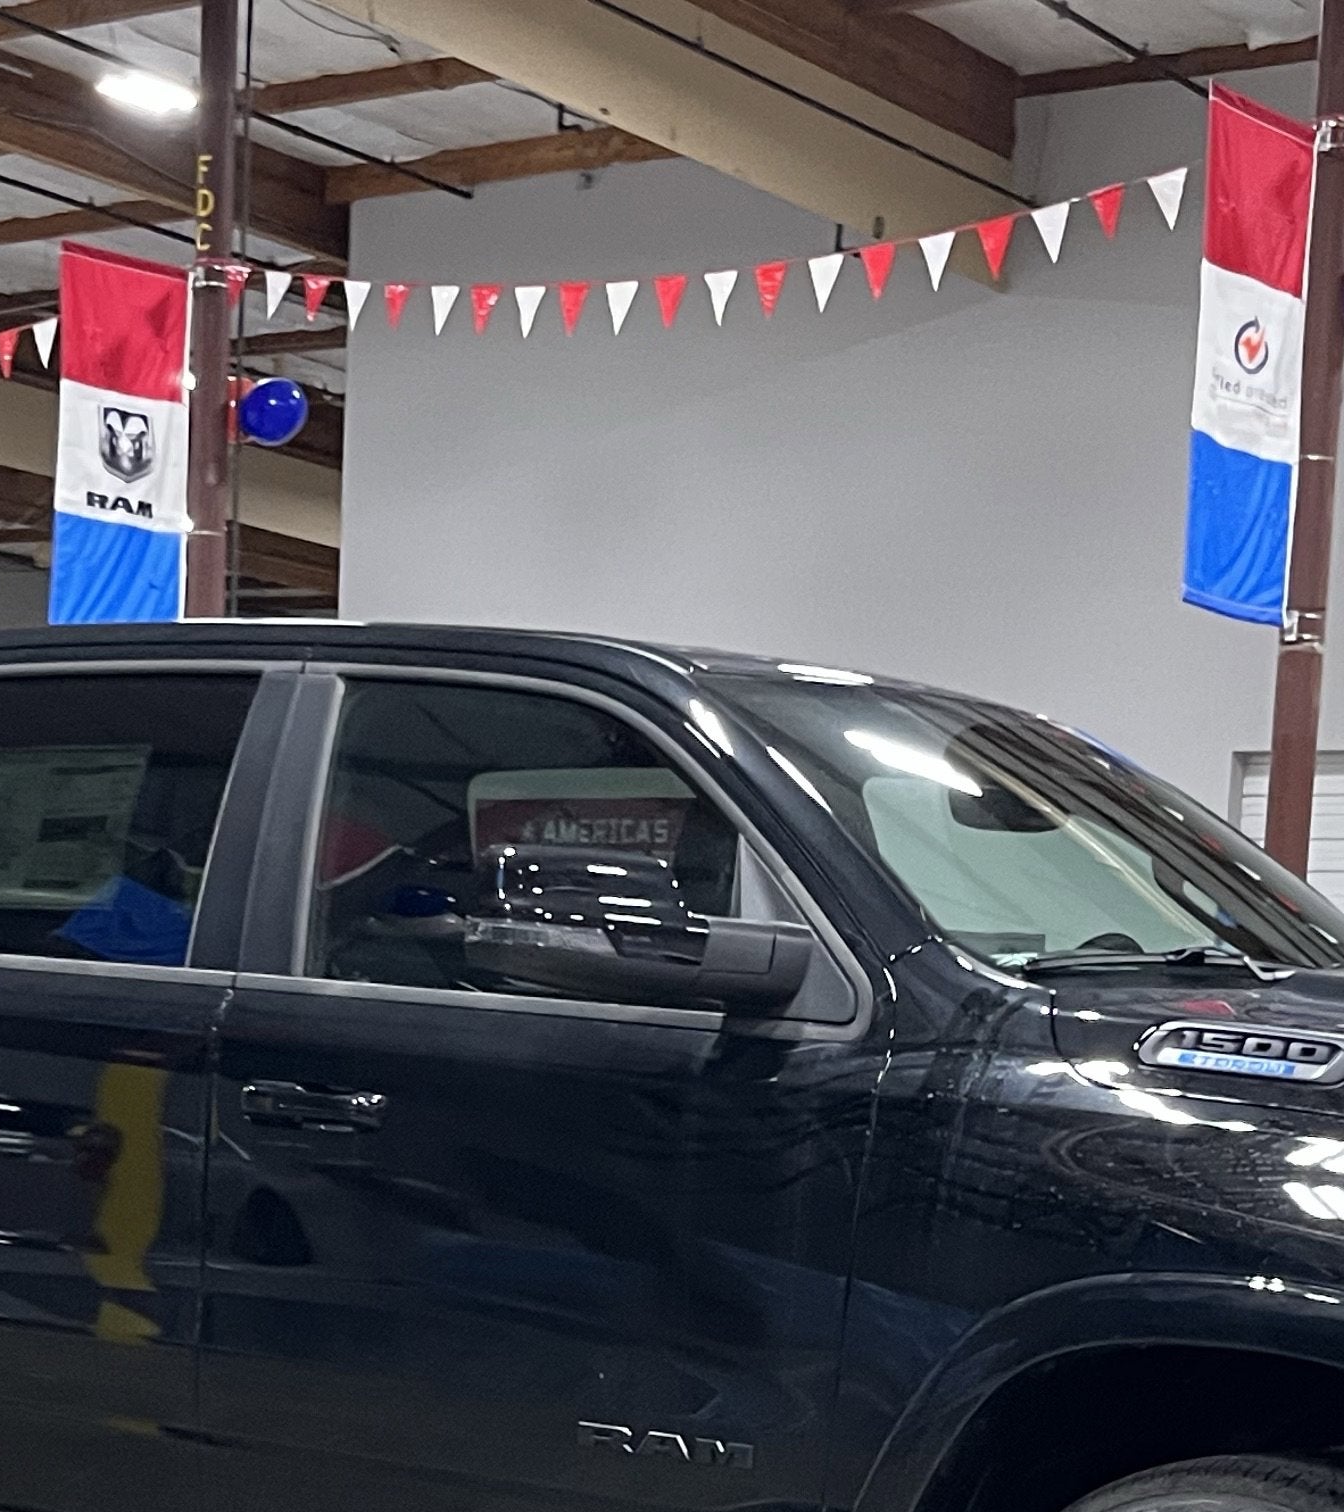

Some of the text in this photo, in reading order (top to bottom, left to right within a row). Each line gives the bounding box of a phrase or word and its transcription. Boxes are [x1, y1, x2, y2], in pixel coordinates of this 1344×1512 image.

[86, 491, 153, 519] RAM
[1180, 1030, 1332, 1063] 1500
[576, 1420, 754, 1470] RAM
